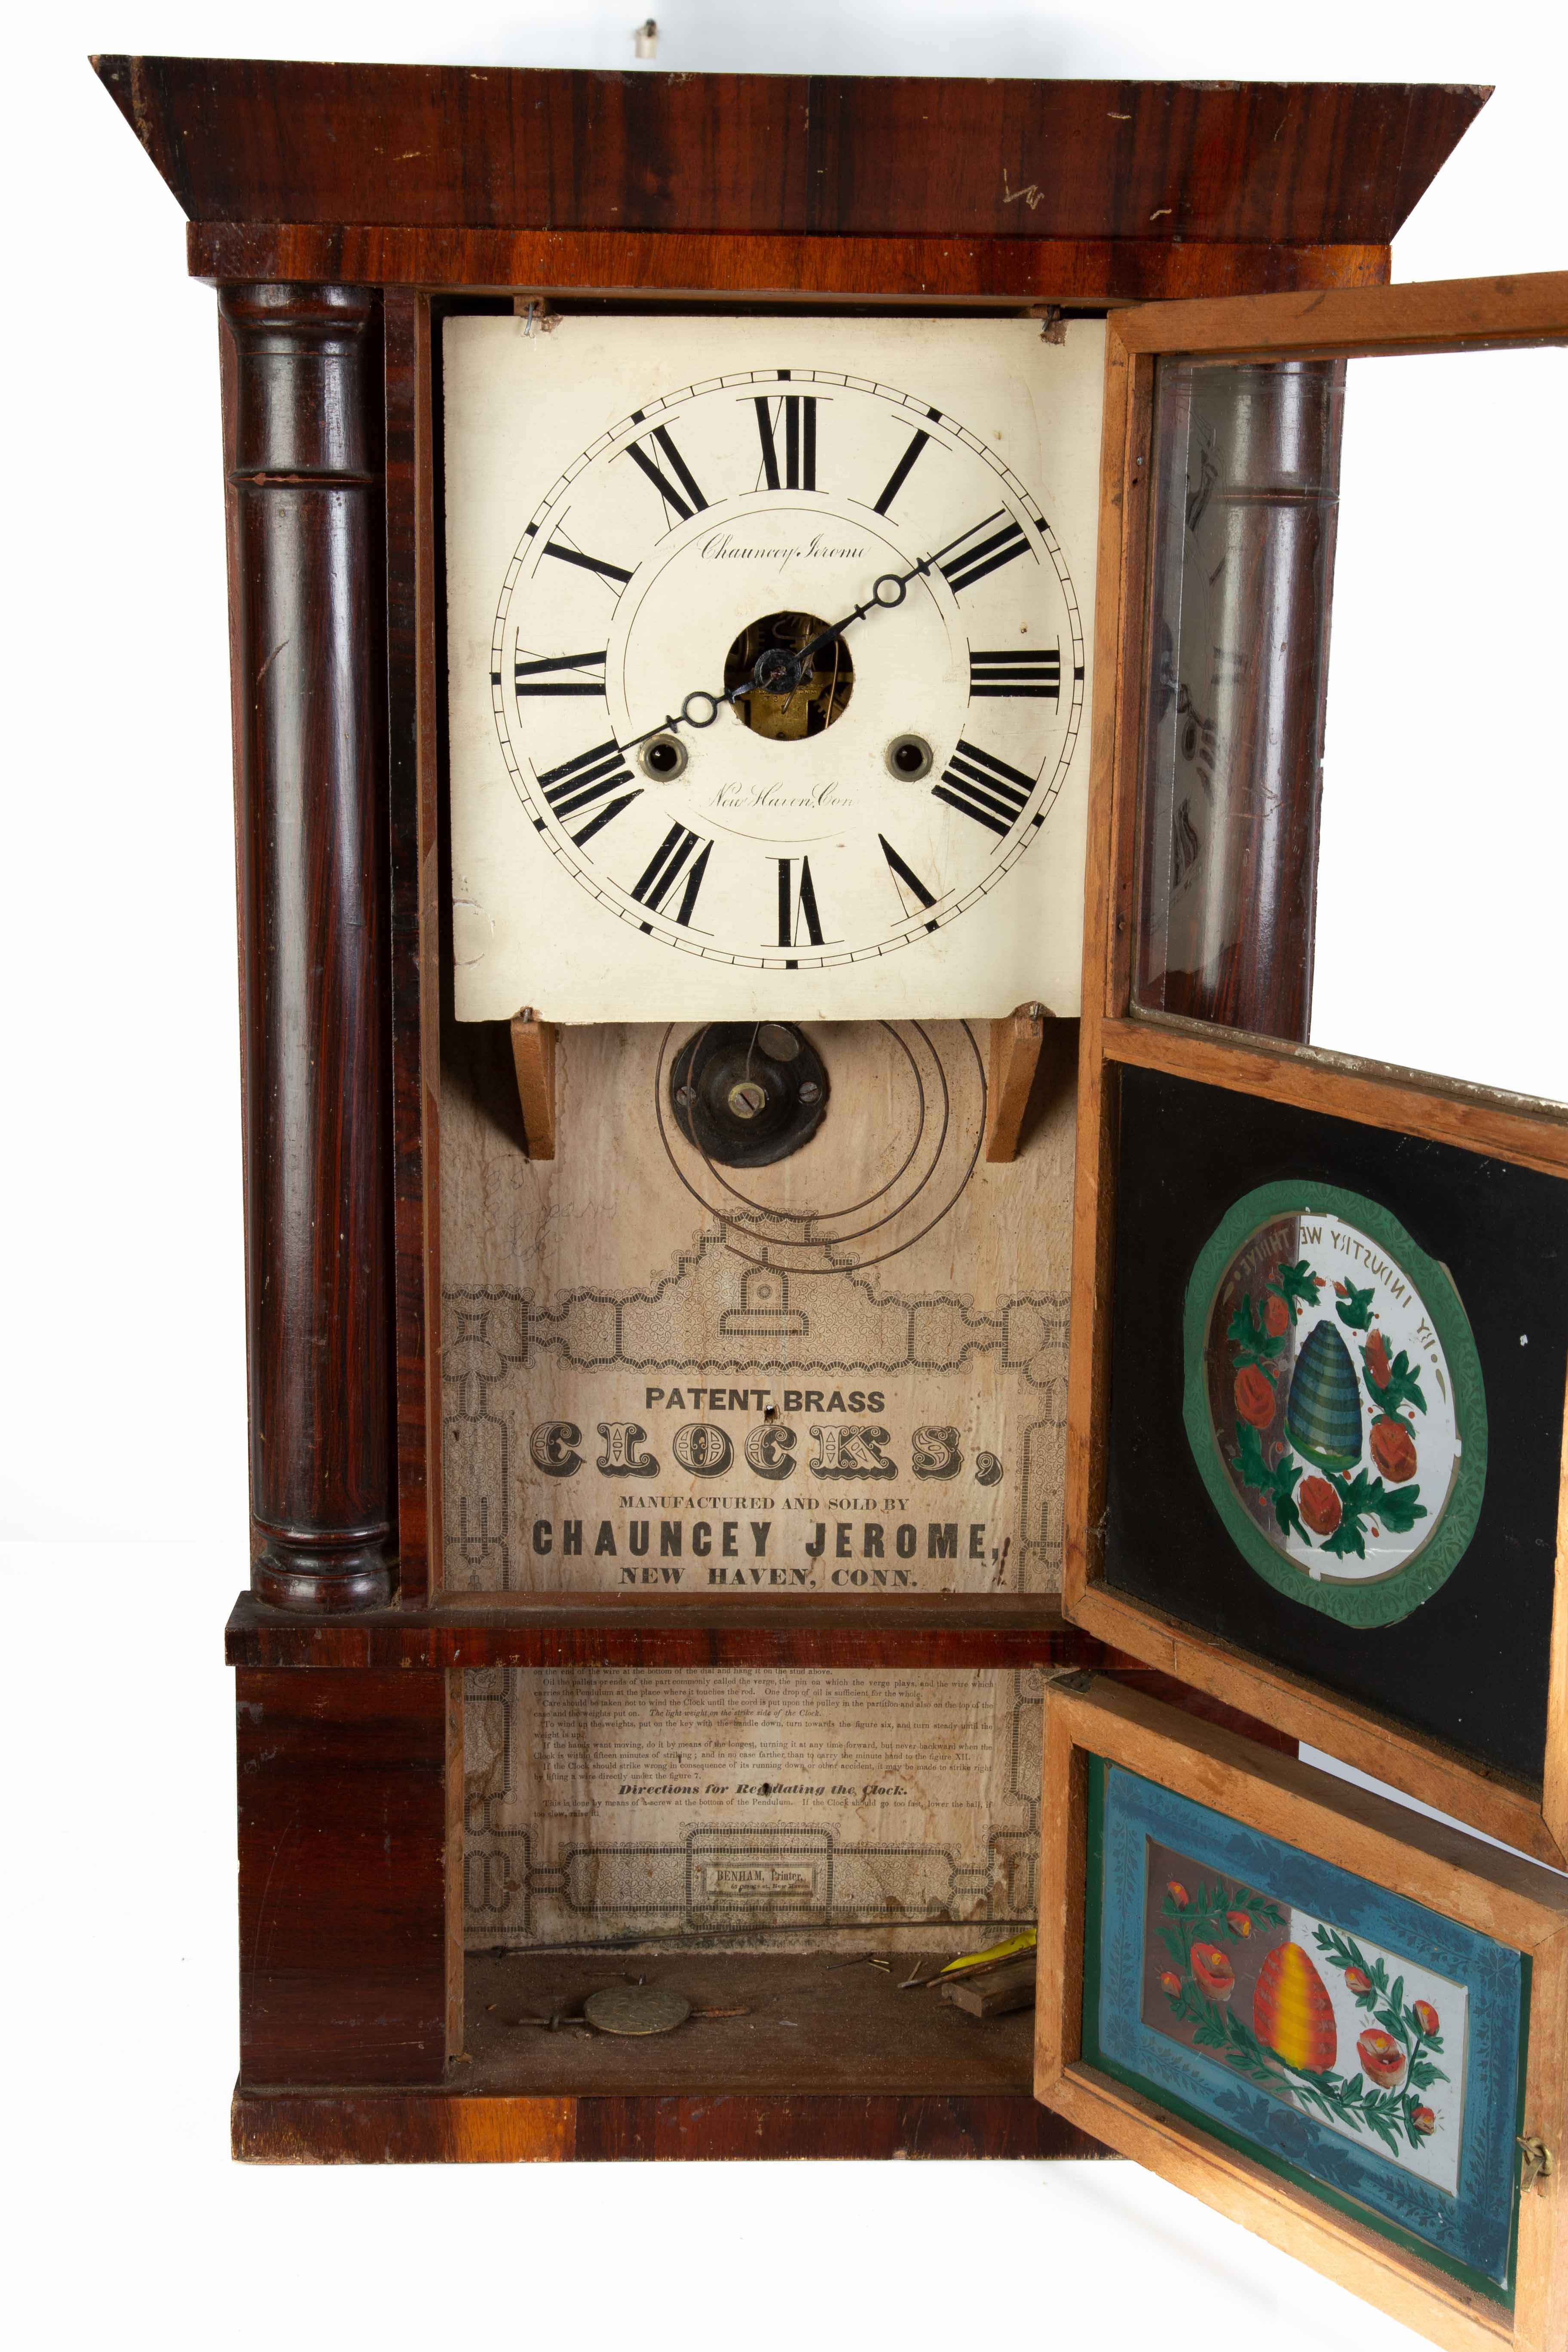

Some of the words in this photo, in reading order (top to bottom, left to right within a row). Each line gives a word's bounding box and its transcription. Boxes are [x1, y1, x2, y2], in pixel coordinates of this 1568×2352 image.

[745, 396, 825, 493] XII
[616, 421, 718, 538] XI
[862, 423, 941, 521] I
[537, 515, 638, 608] X
[697, 533, 799, 574] Chauncey
[796, 533, 871, 558] Jerome
[935, 511, 1036, 601] II
[514, 637, 609, 714] IX
[968, 643, 1060, 706] III
[531, 729, 644, 860] VIII
[709, 781, 748, 808] New
[931, 727, 1045, 851] IIII
[612, 821, 714, 934] VII
[878, 834, 951, 925] V
[769, 855, 834, 947] VI
[646, 1387, 771, 1412] PATENT
[783, 1390, 885, 1413] BRASS
[529, 1421, 1004, 1487] CLOCKS,
[619, 1495, 775, 1510] MANUFACTURED
[782, 1498, 820, 1510] AND
[829, 1498, 877, 1510] SOLD
[882, 1498, 910, 1511] BY
[532, 1519, 772, 1557] CHAUNCEY
[805, 1522, 1000, 1561] JEROME,
[618, 1568, 686, 1585] NEW
[707, 1568, 816, 1589] HAVEN,
[831, 1569, 917, 1587] CONN.
[583, 1709, 610, 1718] weights
[614, 1710, 625, 1718] put
[666, 1709, 681, 1718] light
[685, 1709, 707, 1718] weight
[641, 1688, 660, 1698] place
[783, 1687, 799, 1697] drop
[614, 1741, 643, 1750] moving,
[667, 1740, 675, 1750] by
[728, 1740, 756, 1749] longest,
[760, 1740, 787, 1749] turning
[846, 1741, 877, 1749] forward,
[664, 1751, 691, 1761] striking
[930, 1752, 951, 1762] figure
[534, 1772, 543, 1782] by
[547, 1772, 568, 1782] lifting
[599, 1772, 627, 1781] directly
[670, 1771, 691, 1781] figure
[543, 1761, 551, 1770] If
[680, 1763, 726, 1771] consequence
[753, 1761, 781, 1770] running
[841, 1762, 873, 1770] accident,
[886, 1764, 901, 1773] may
[974, 1763, 992, 1773] right
[618, 1784, 699, 1795] Directions
[705, 1784, 729, 1794] for
[735, 1784, 826, 1796] Regulating
[831, 1785, 854, 1795] the
[863, 1785, 908, 1795] Clock.
[716, 1871, 765, 1882] BENHAM,
